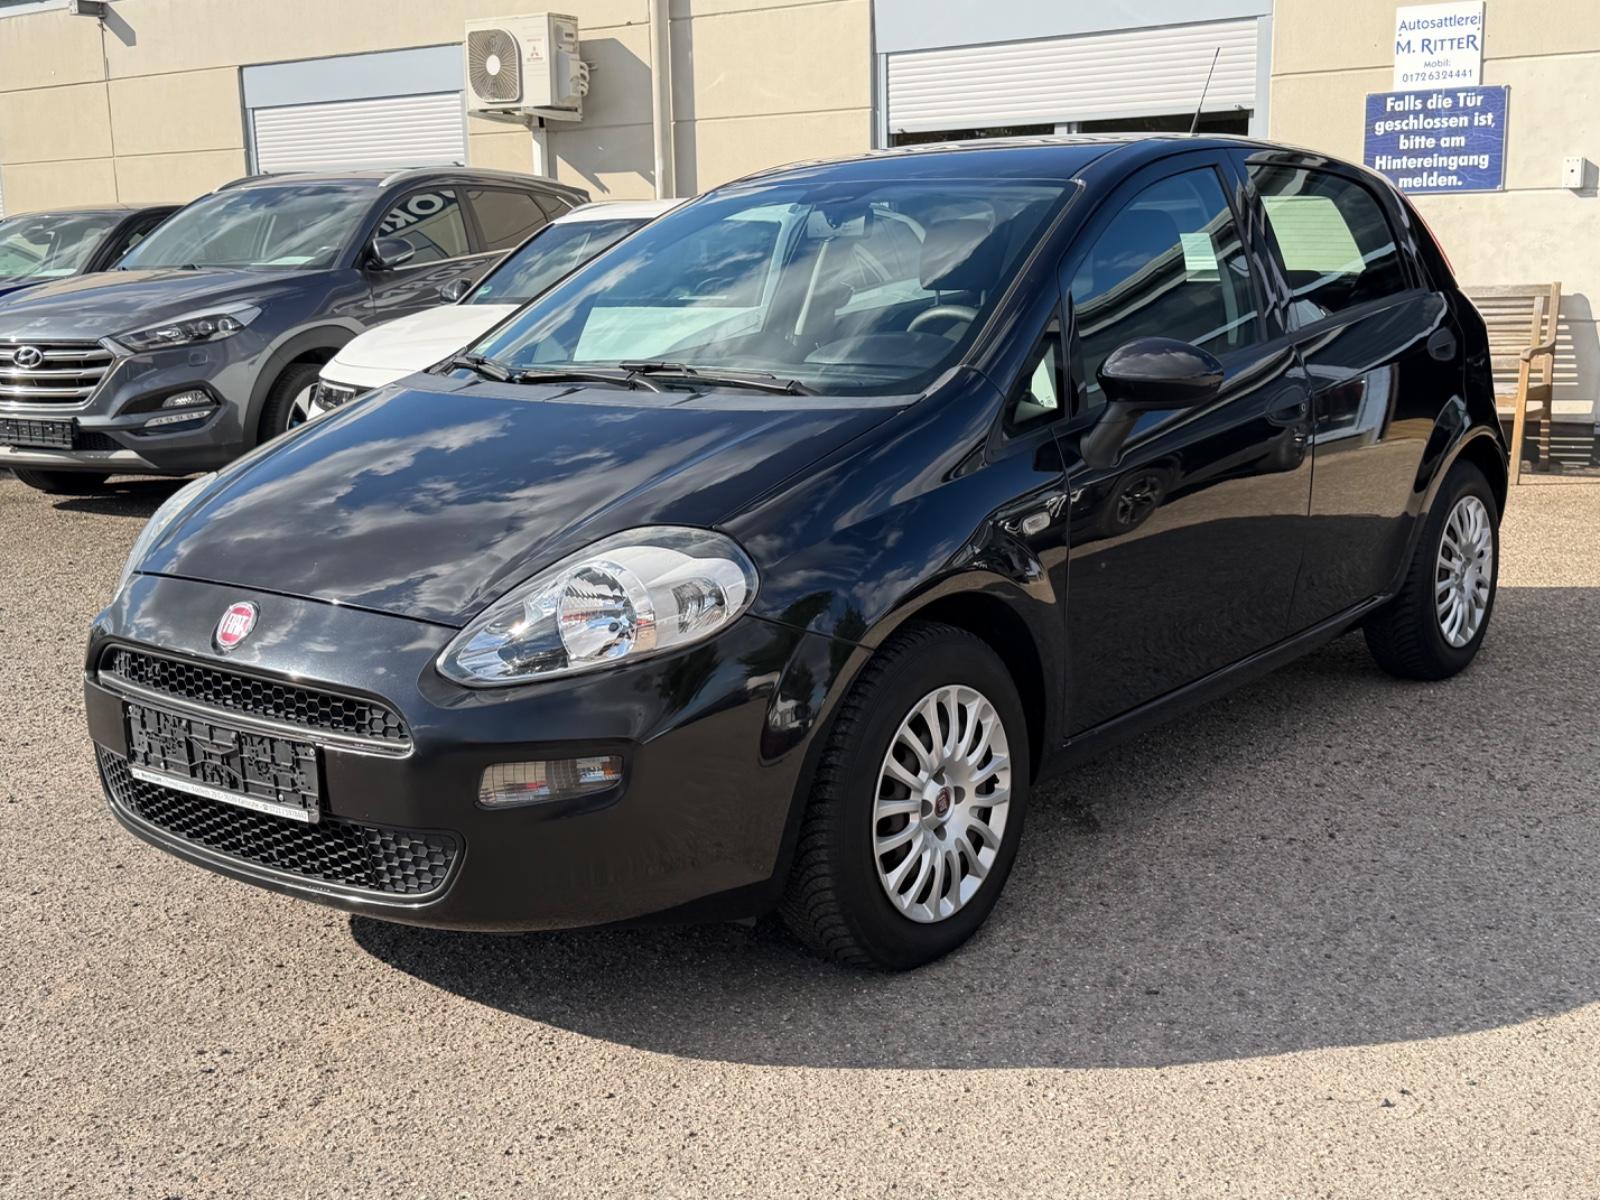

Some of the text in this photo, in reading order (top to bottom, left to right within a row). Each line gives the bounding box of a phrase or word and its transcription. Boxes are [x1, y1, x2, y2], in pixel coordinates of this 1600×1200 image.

[1398, 11, 1481, 31] Autosattlerei
[1396, 34, 1479, 55] M. RITTER
[1423, 59, 1451, 68] Mobil:
[1386, 92, 1484, 112] Falls die Tür
[1375, 112, 1495, 135] geschlossen ist,
[1399, 134, 1465, 150] bitte am
[1375, 153, 1489, 170] Hintereingang
[1398, 171, 1462, 188] melden.
